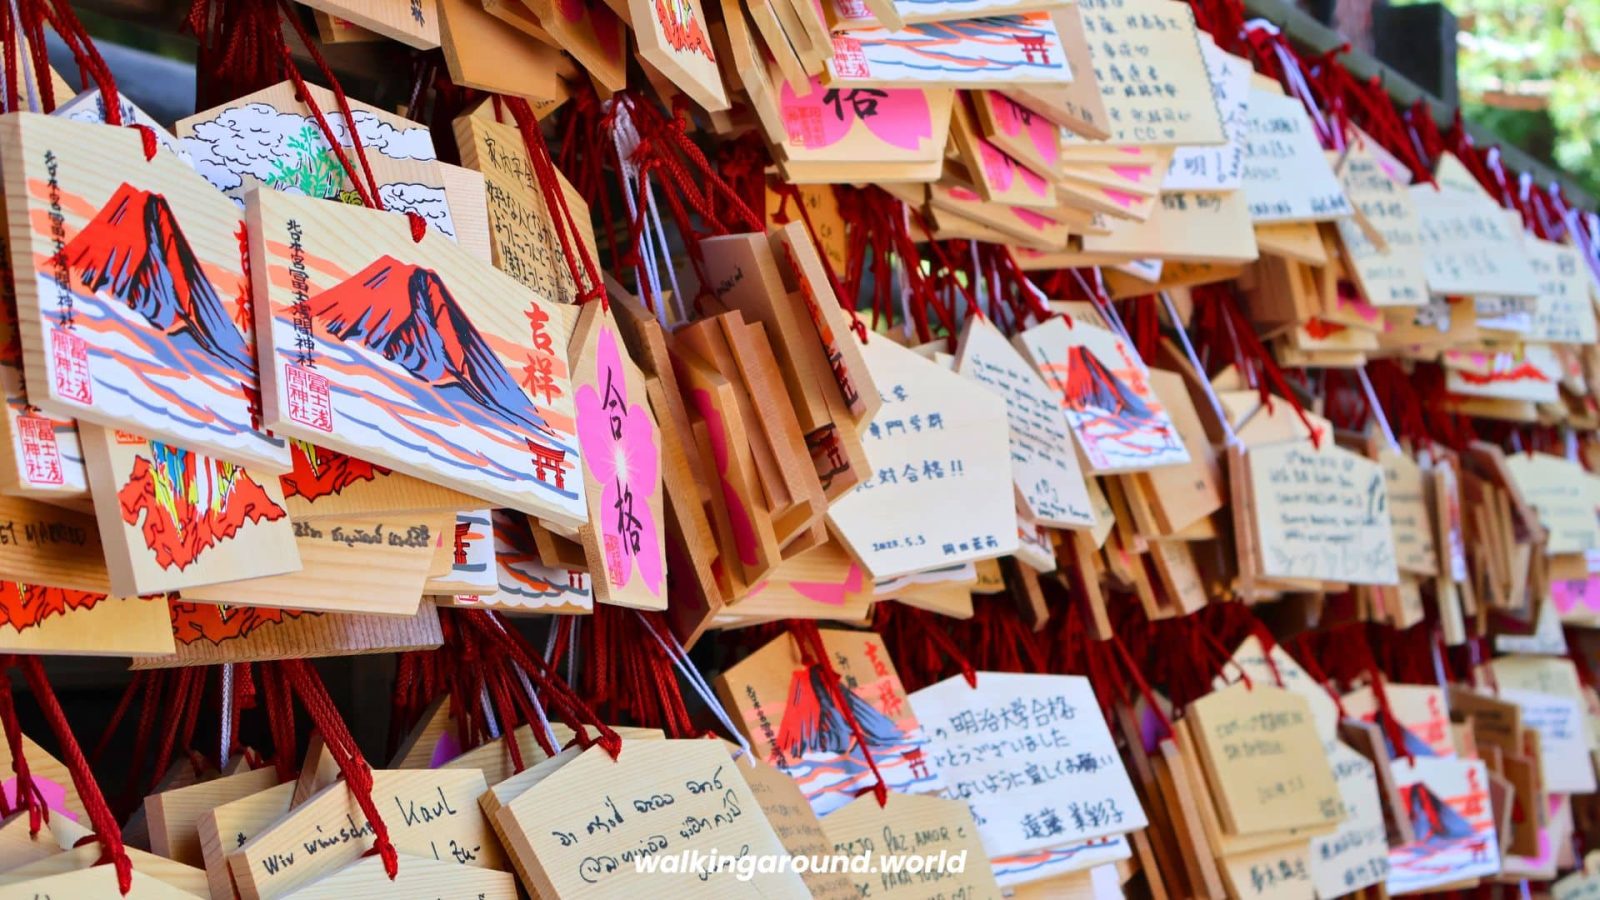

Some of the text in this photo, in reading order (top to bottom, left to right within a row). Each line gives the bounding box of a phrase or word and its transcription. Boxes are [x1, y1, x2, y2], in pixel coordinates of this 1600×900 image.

[522, 302, 562, 405] 吉祥
[602, 366, 643, 556] 合格
[262, 847, 295, 876] Wir
